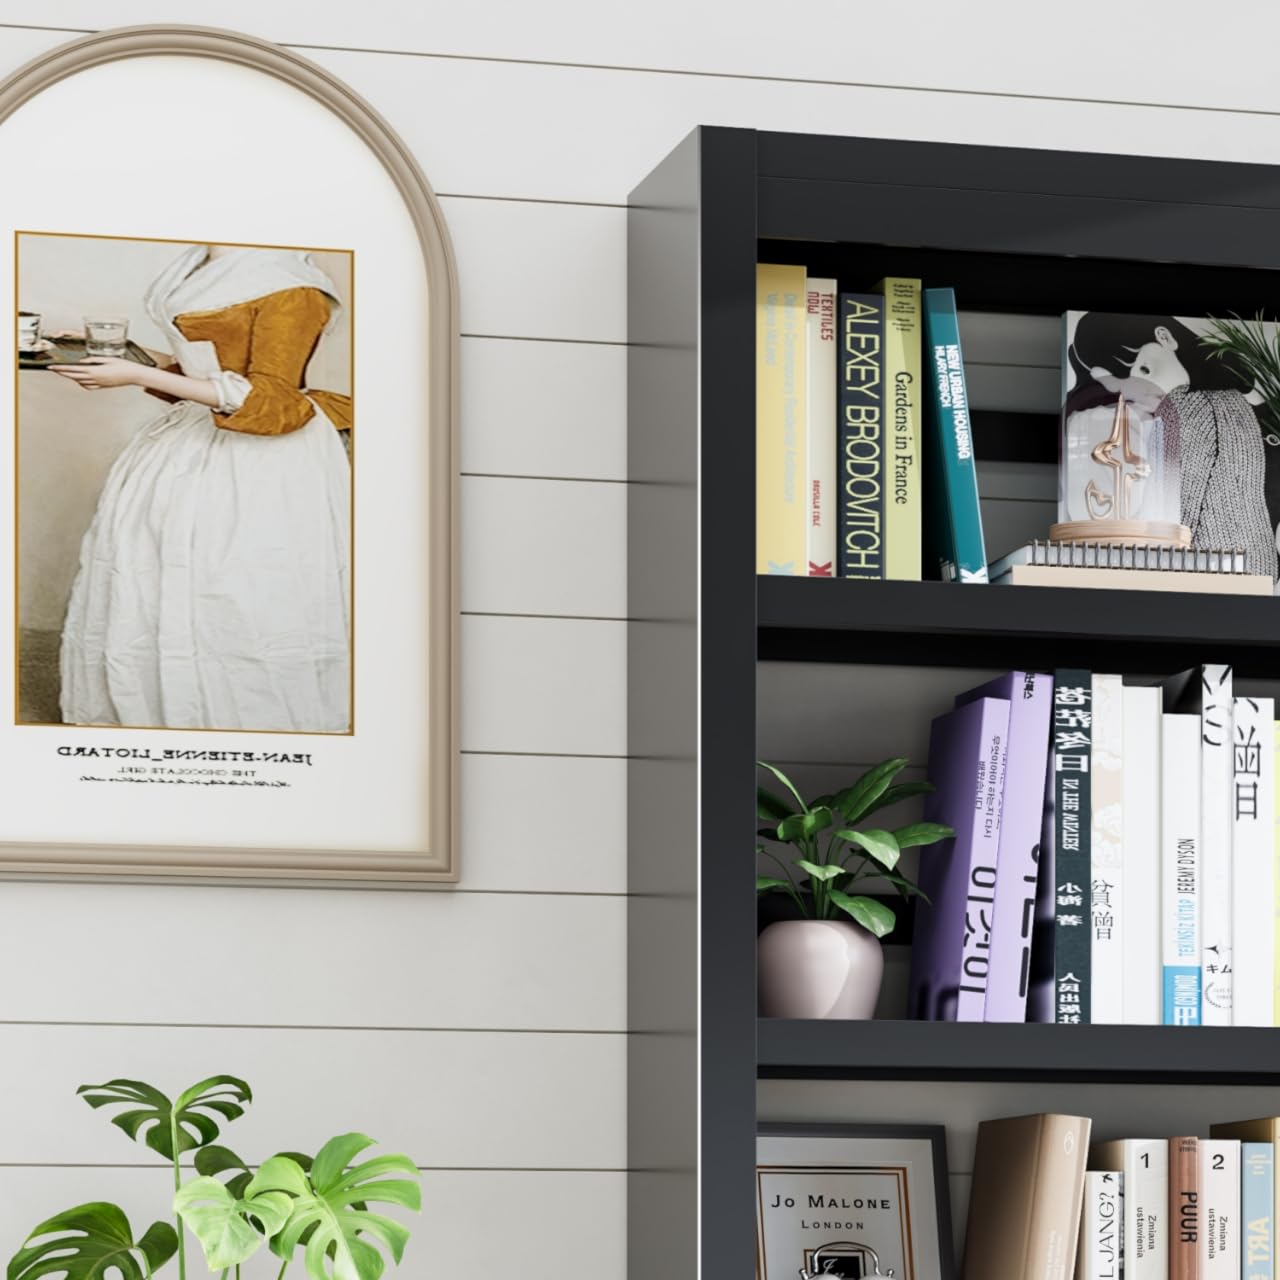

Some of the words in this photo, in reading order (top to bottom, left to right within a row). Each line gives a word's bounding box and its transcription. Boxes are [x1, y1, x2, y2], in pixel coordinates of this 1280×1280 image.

[808, 291, 820, 315] NOW
[821, 292, 834, 342] TEXTILES
[845, 300, 880, 399] ALEXEY
[946, 345, 960, 369] NEW
[895, 371, 913, 432] Gardens
[949, 372, 965, 408] URBAN
[895, 436, 910, 450] in
[953, 410, 971, 460] HOUSING
[845, 405, 880, 569] BRODOVITCH
[895, 455, 910, 505] France
[1177, 838, 1195, 865] DYSON
[1177, 867, 1195, 894] JEREMY
[1140, 1153, 1149, 1169] 1
[1212, 1154, 1224, 1170] 2
[808, 1195, 891, 1209] MALONE
[1181, 1192, 1197, 1243] PUUR
[802, 1221, 864, 1230] LONDON
[1099, 1192, 1115, 1263] JANG?
[1136, 1207, 1144, 1258] ustawienia
[1147, 1215, 1155, 1250] Zmiana
[1208, 1208, 1216, 1259] ustawienia
[1219, 1216, 1227, 1251] Zmiana
